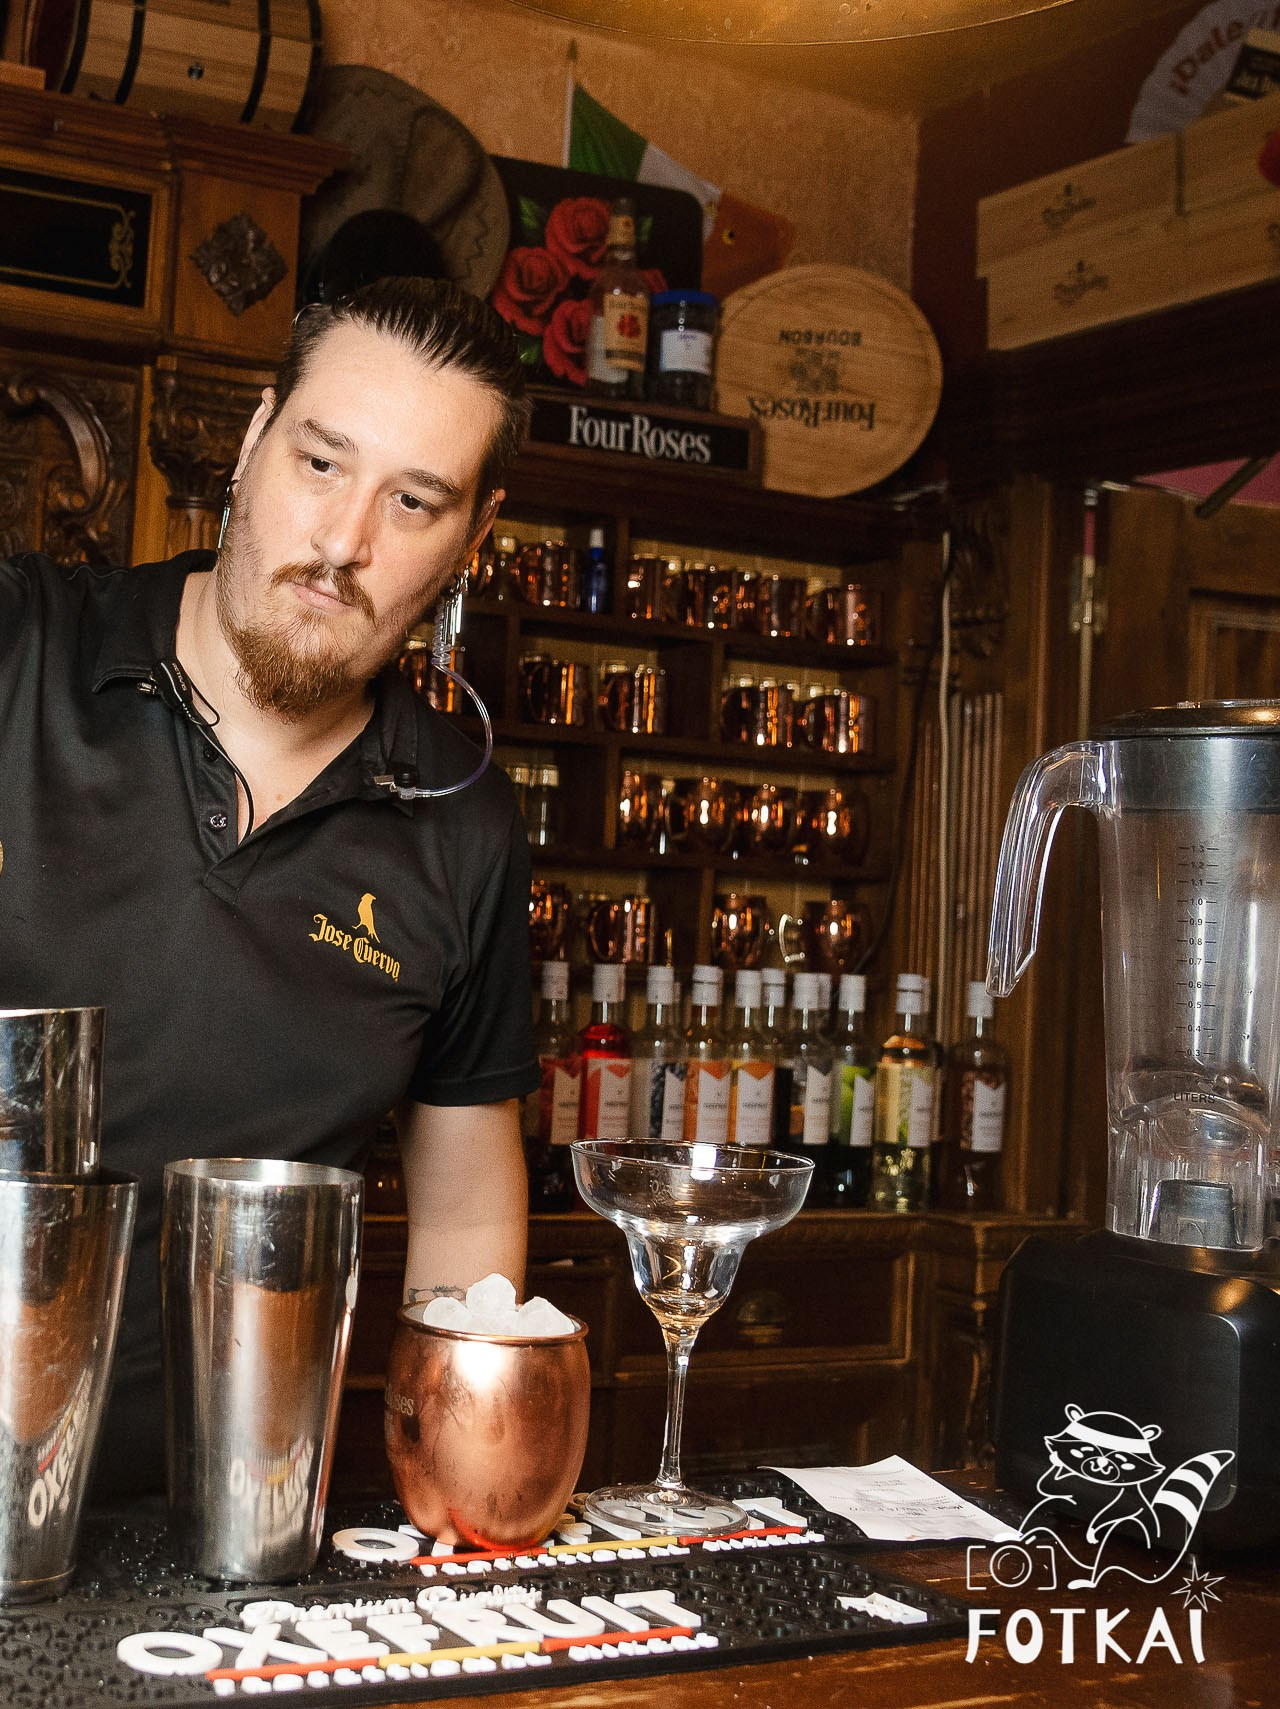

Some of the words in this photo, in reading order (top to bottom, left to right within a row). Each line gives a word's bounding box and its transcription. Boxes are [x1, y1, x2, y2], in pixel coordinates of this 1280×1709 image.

[747, 395, 821, 429] Roses
[824, 401, 876, 431] Four
[569, 404, 631, 451] Four
[631, 414, 712, 464] Roses
[1191, 861, 1205, 870] 1.2
[1190, 898, 1204, 906] 1.0
[1189, 918, 1203, 926] 0.9
[1189, 937, 1203, 946] 0.8
[308, 913, 353, 952] Jose
[353, 937, 401, 980] Cuervo
[1188, 956, 1203, 966] 0.7
[1188, 981, 1202, 989] 0.6
[1187, 1001, 1202, 1009] 0.5
[1187, 1024, 1201, 1033] 0.4
[1187, 1048, 1200, 1057] 0.3
[1174, 1092, 1216, 1104] LITERS
[116, 1588, 703, 1677] OXEFRUIT
